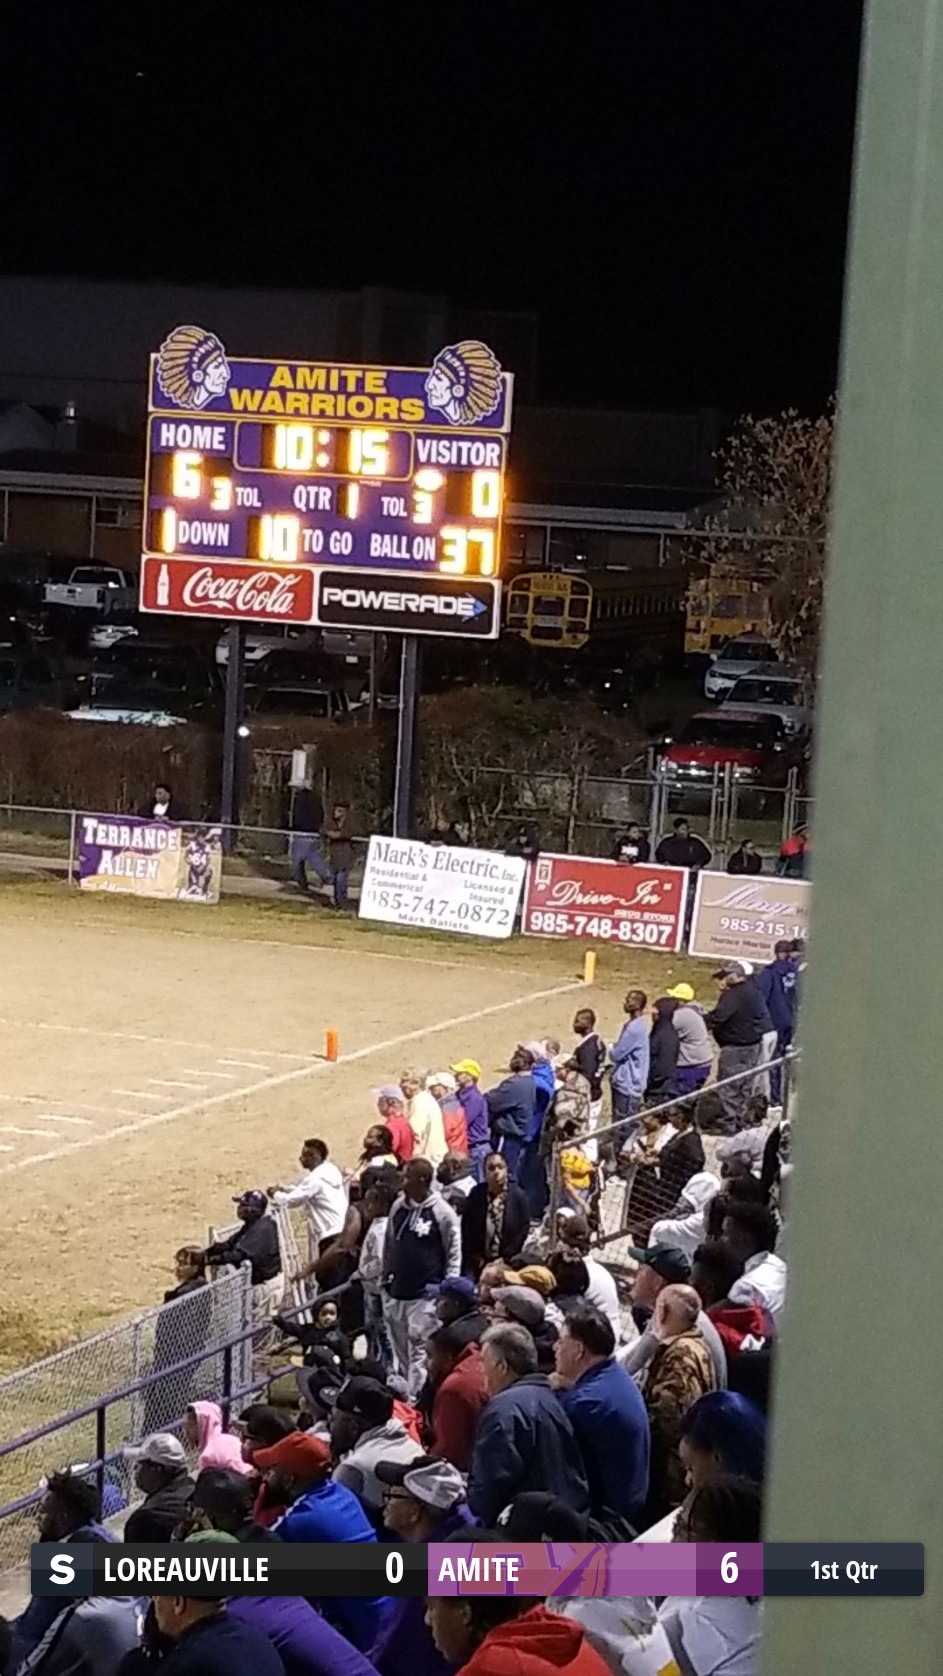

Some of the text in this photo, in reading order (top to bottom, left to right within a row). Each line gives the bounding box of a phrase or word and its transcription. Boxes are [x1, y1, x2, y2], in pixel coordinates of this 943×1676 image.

[269, 365, 388, 394] AMITE
[229, 388, 426, 422] WARRIORS
[160, 423, 227, 451] HOME
[274, 423, 389, 476] 10:15
[416, 438, 501, 467] VISITOR
[173, 451, 202, 499] 6
[211, 477, 232, 511] 3
[235, 486, 262, 509] TOL
[293, 485, 332, 512] QTR
[347, 482, 359, 519] 1
[381, 496, 408, 518] TOL
[472, 470, 499, 518] 0
[162, 507, 176, 553] 1
[179, 521, 230, 547] DOWN
[259, 514, 299, 562] 10
[302, 529, 353, 556] TO GO
[370, 534, 437, 561] BALL ON
[440, 527, 495, 576] 37
[183, 567, 302, 615] Coca-Cola
[322, 586, 477, 617] POWERADE
[82, 817, 178, 850] TERRANCE
[97, 849, 160, 879] ALLEN
[372, 841, 430, 870] Mark's
[501, 869, 519, 883] Inc.
[421, 872, 428, 882] &
[464, 879, 506, 894] Licensed
[469, 892, 505, 906] Insured
[530, 911, 673, 946] 985-748-8307
